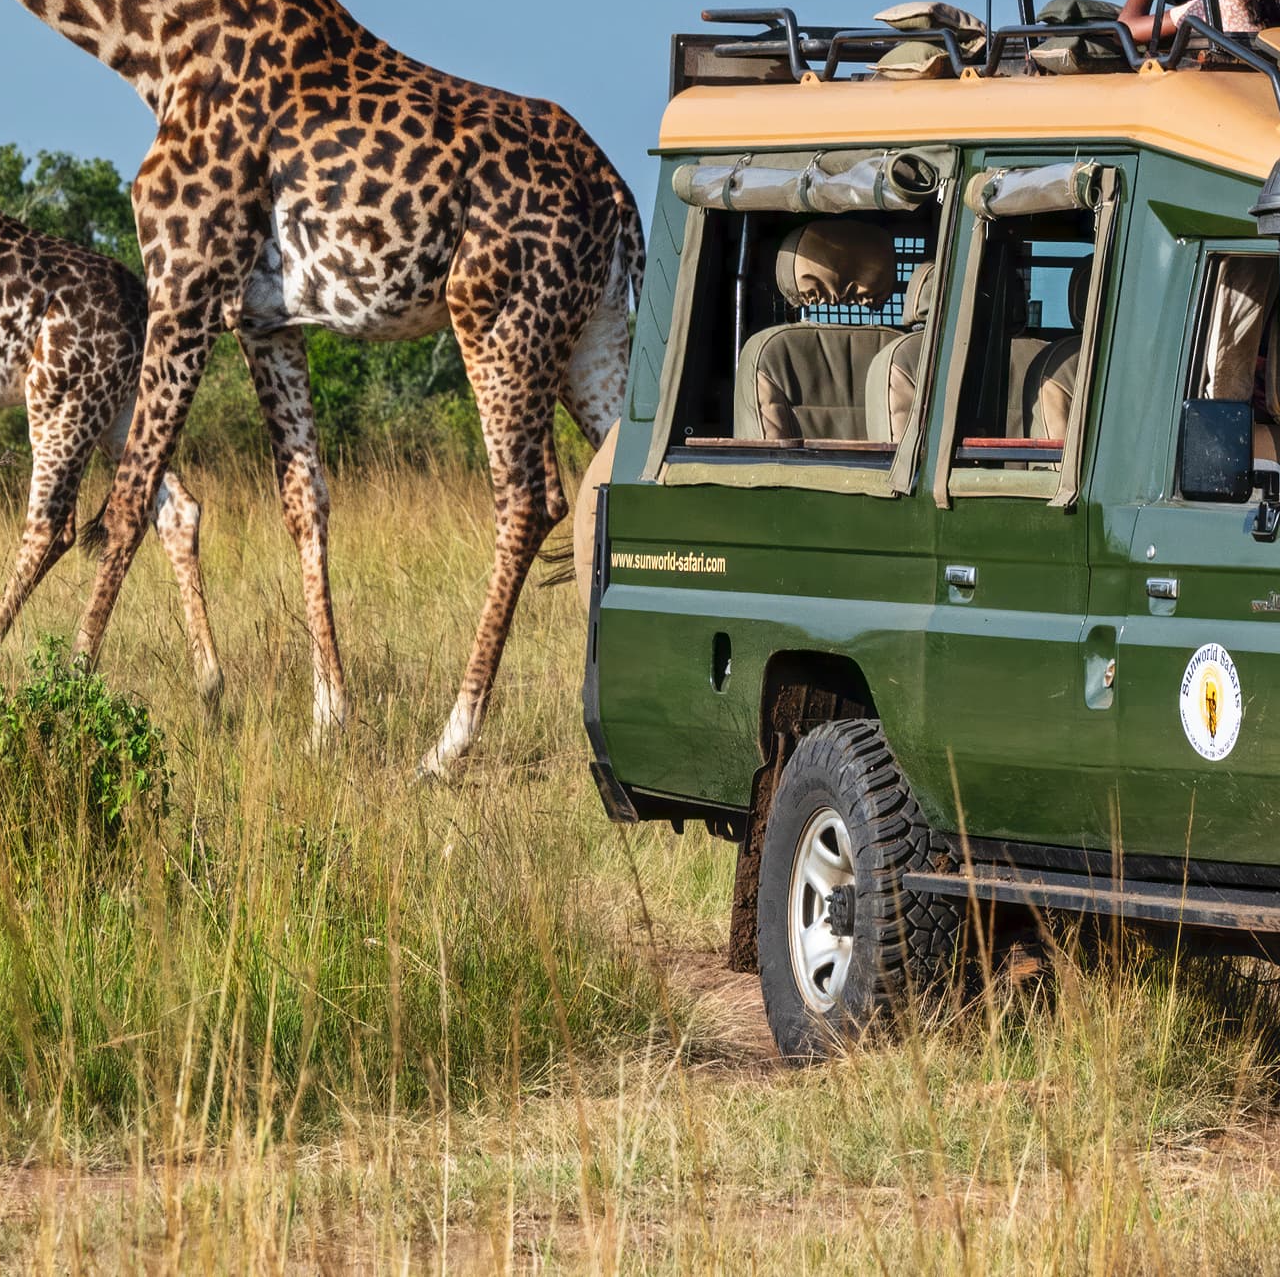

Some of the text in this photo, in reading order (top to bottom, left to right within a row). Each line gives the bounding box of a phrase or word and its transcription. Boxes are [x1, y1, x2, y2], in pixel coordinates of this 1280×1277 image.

[611, 551, 726, 573] www.sunworld-safari.com
[1182, 644, 1241, 709] Sunworld Safaris
